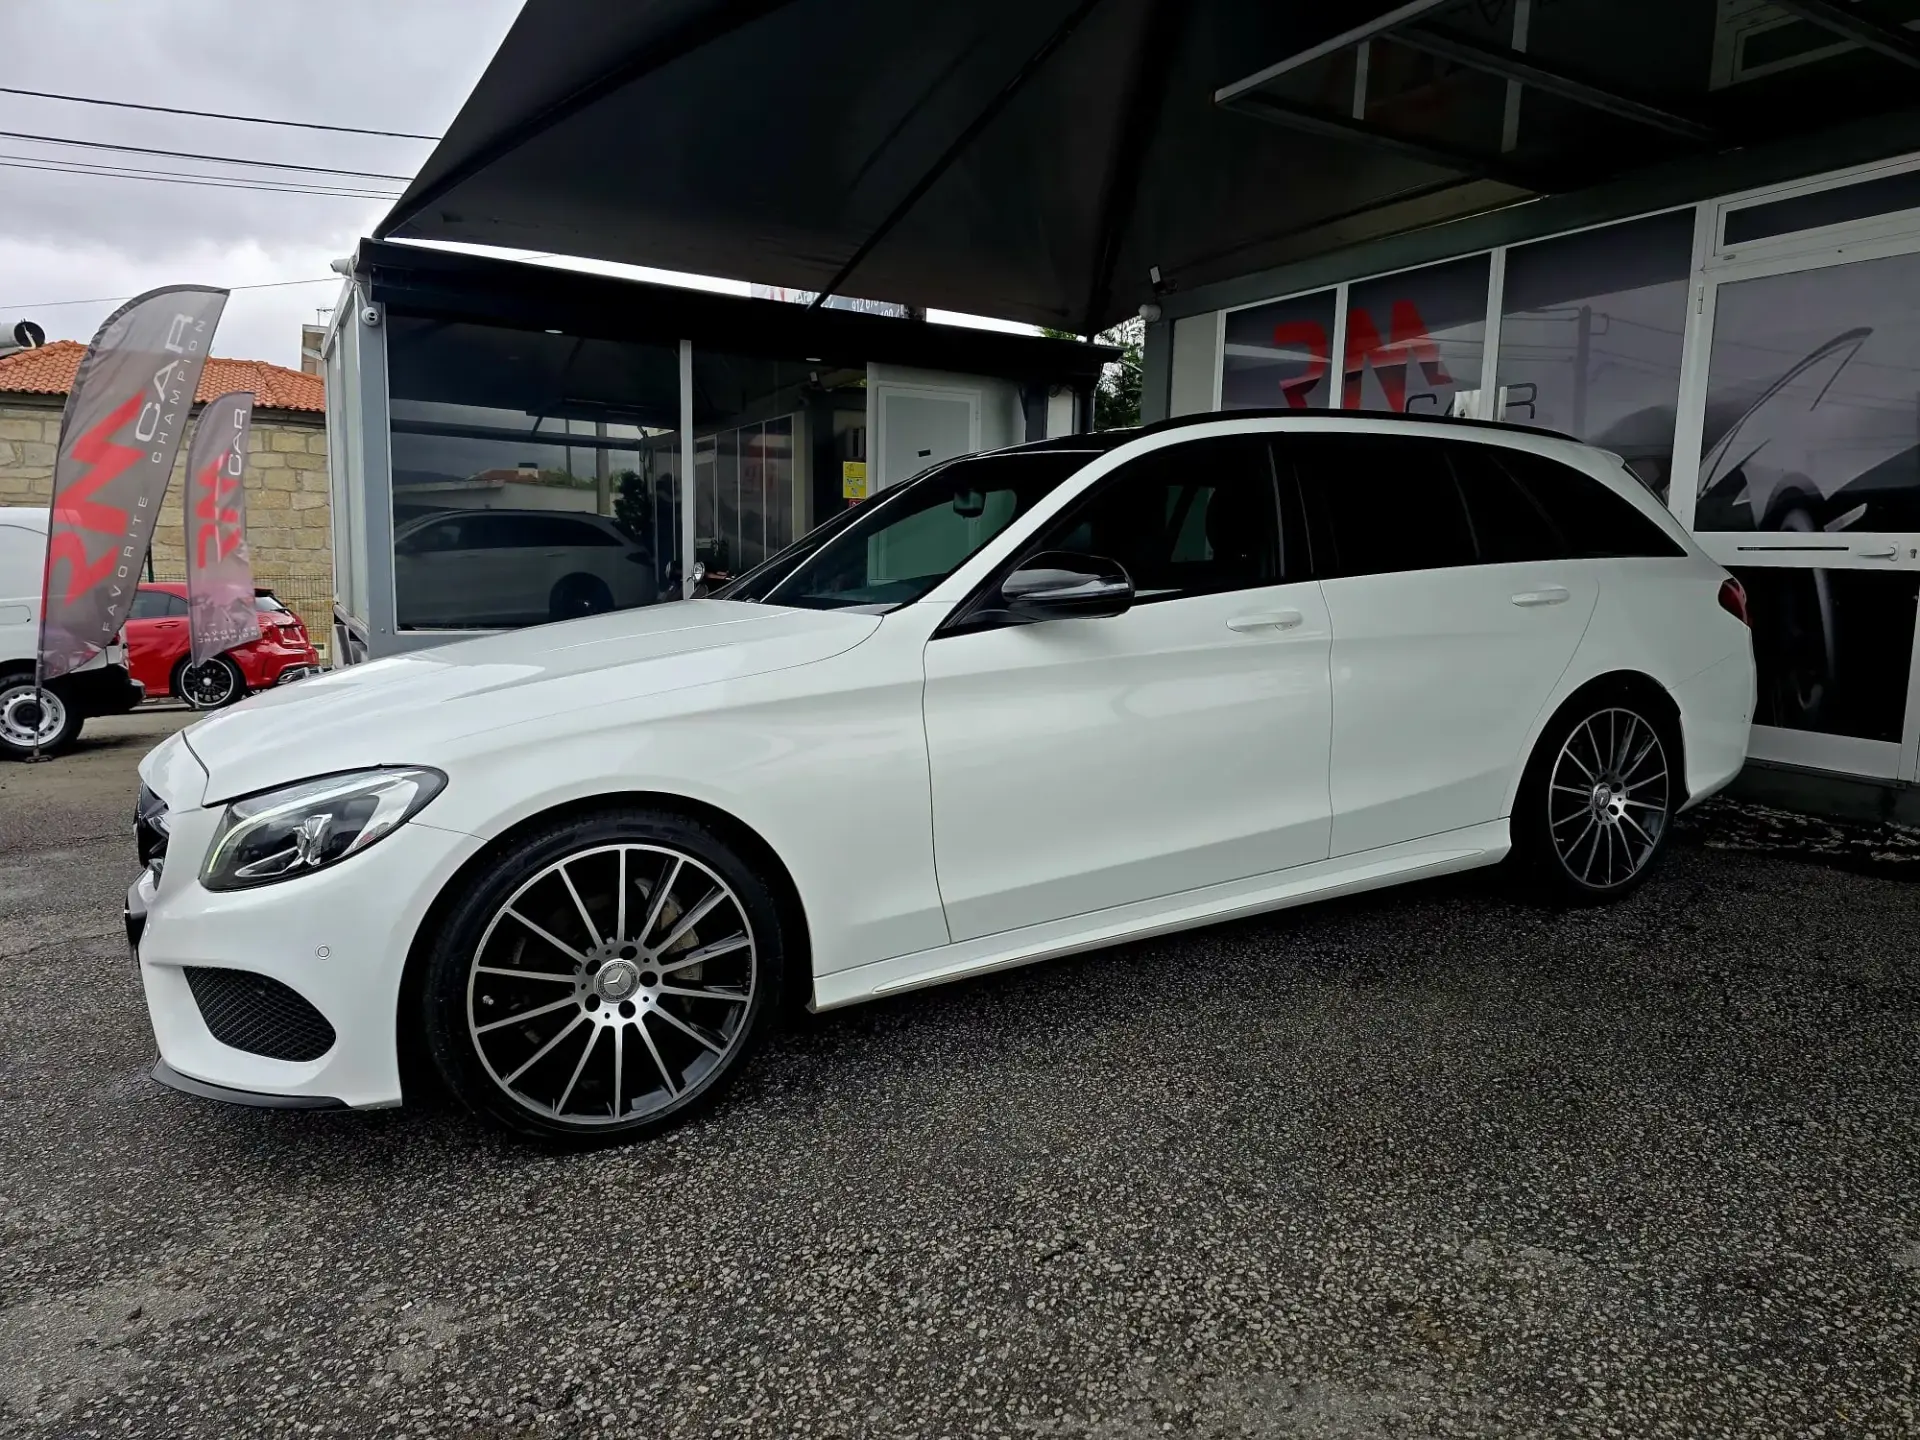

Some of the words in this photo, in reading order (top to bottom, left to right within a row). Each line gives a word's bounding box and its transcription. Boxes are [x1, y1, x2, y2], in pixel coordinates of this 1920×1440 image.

[135, 313, 194, 442] CAR
[1405, 382, 1538, 419] CR
[102, 496, 149, 632] FAVORITE
[152, 320, 206, 464] CHAMPION
[228, 408, 247, 476] CAR
